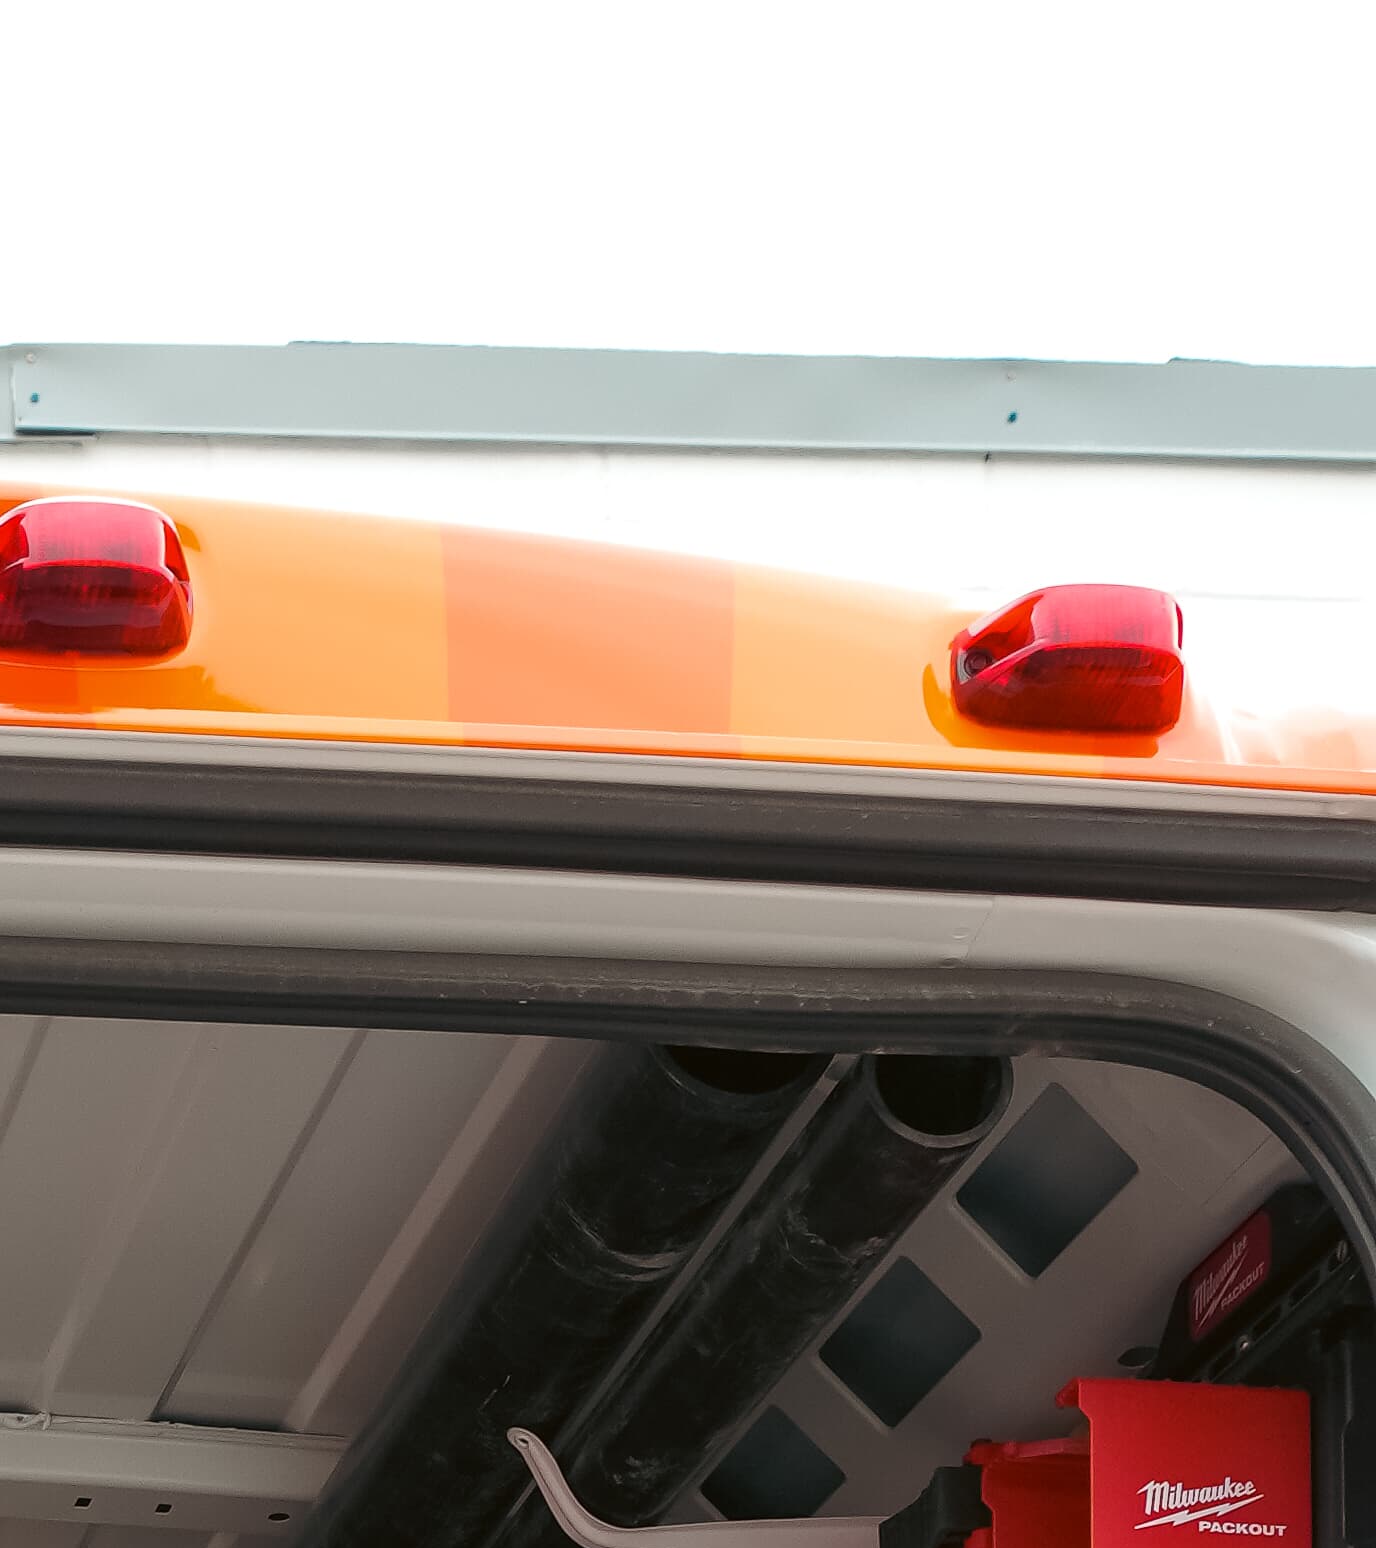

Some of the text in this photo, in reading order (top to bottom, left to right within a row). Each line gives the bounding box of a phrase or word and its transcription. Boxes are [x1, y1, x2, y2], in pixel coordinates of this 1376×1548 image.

[1220, 1262, 1265, 1310] PACKOUT
[1136, 1477, 1257, 1514] Milwaukee
[1199, 1521, 1287, 1536] PACKOUT
